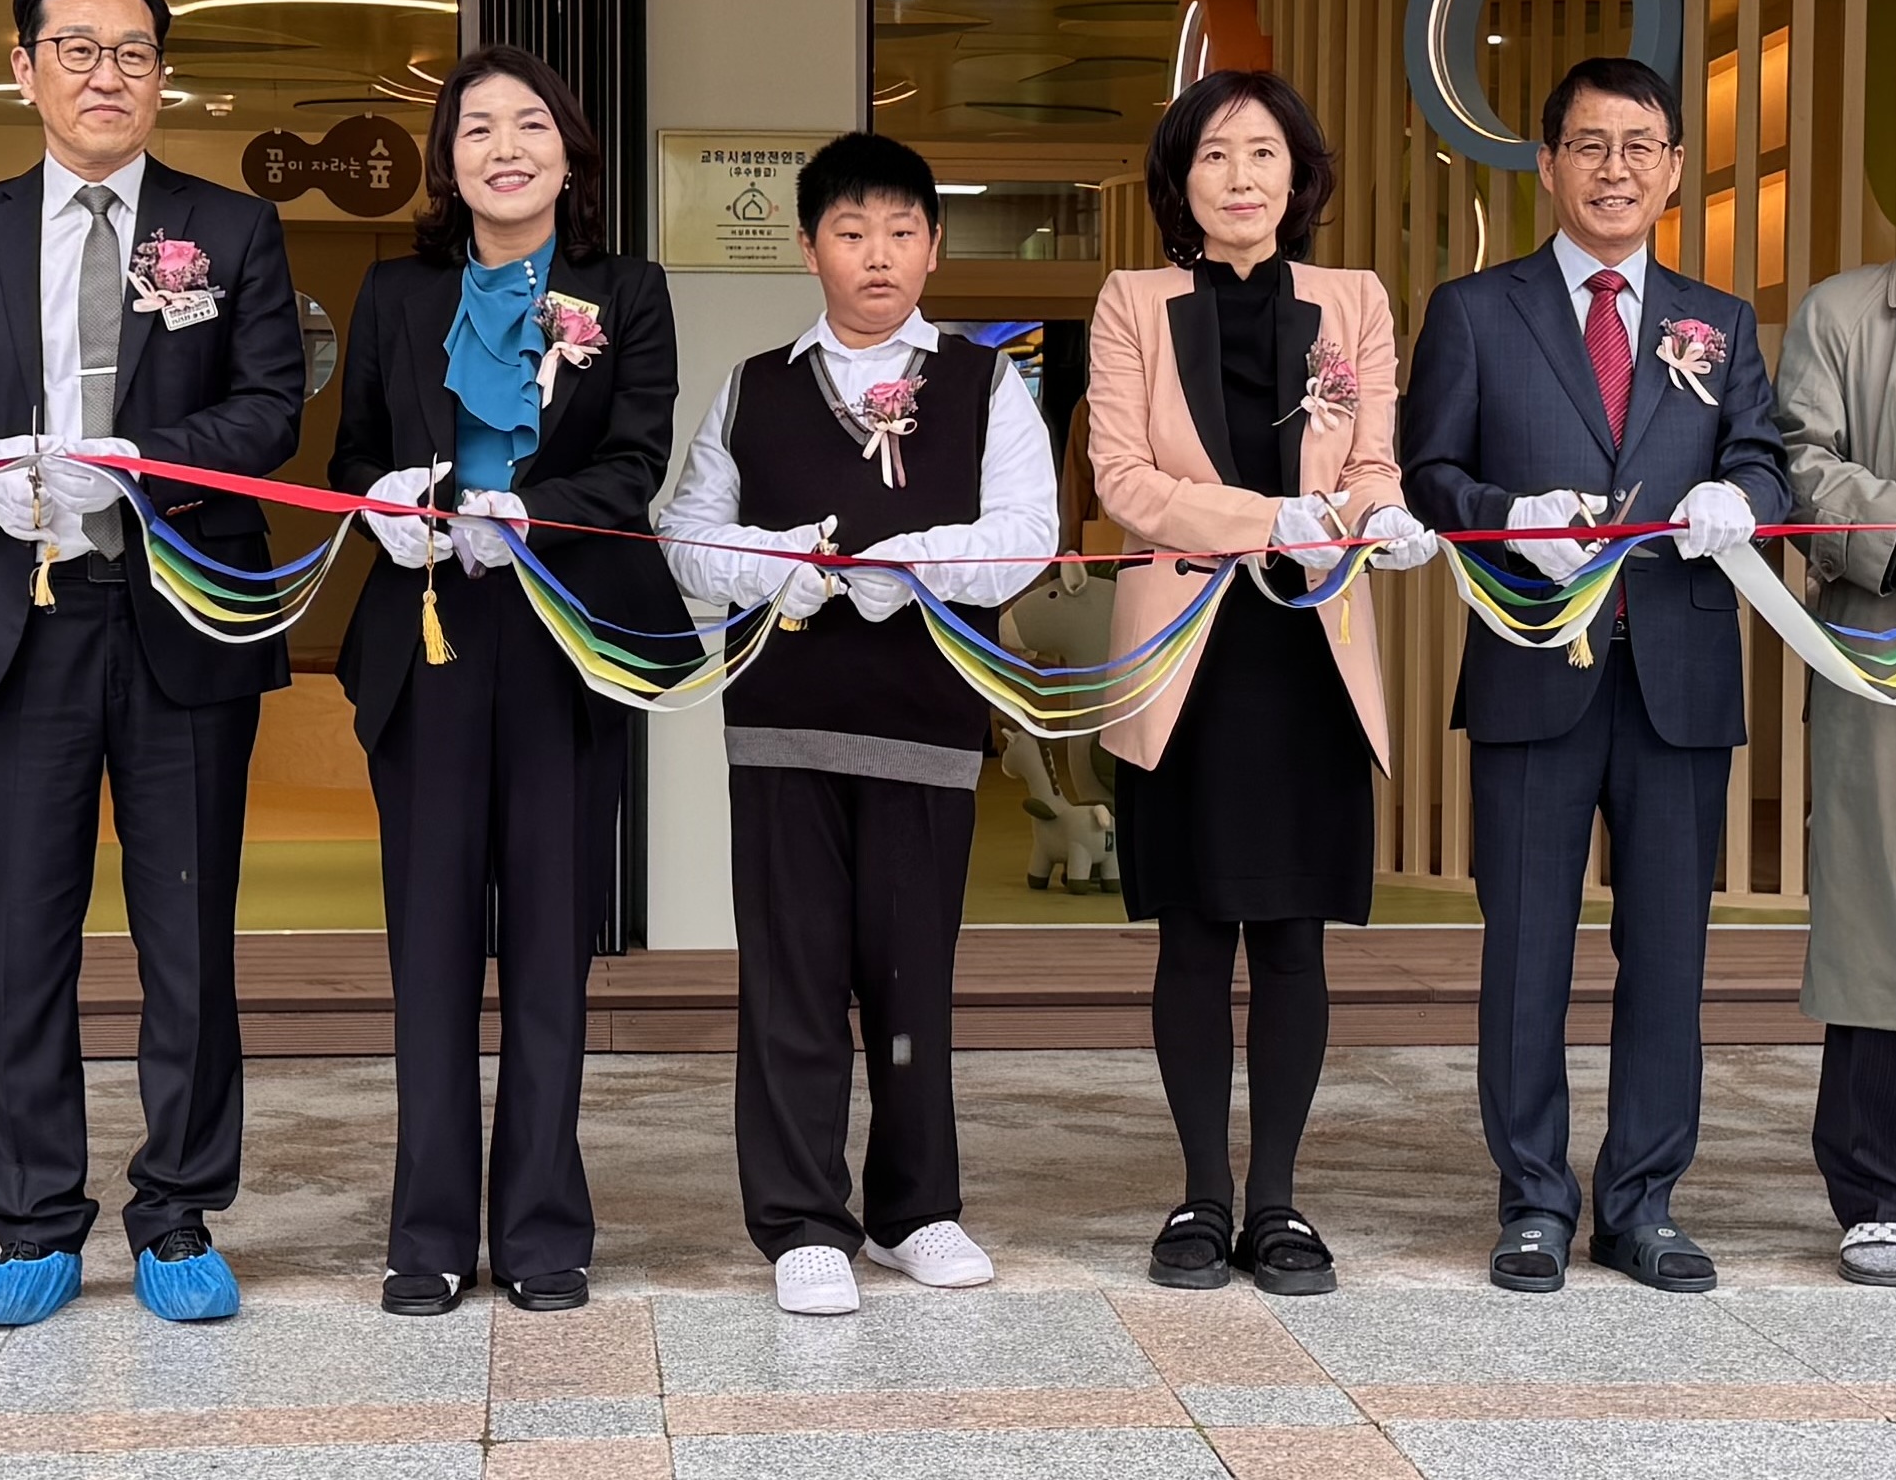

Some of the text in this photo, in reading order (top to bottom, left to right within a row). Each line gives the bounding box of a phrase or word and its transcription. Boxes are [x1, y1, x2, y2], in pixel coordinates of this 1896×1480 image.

[265, 138, 393, 189] 꿈이 자라는 숲
[701, 150, 807, 165] 교육시설안전인증
